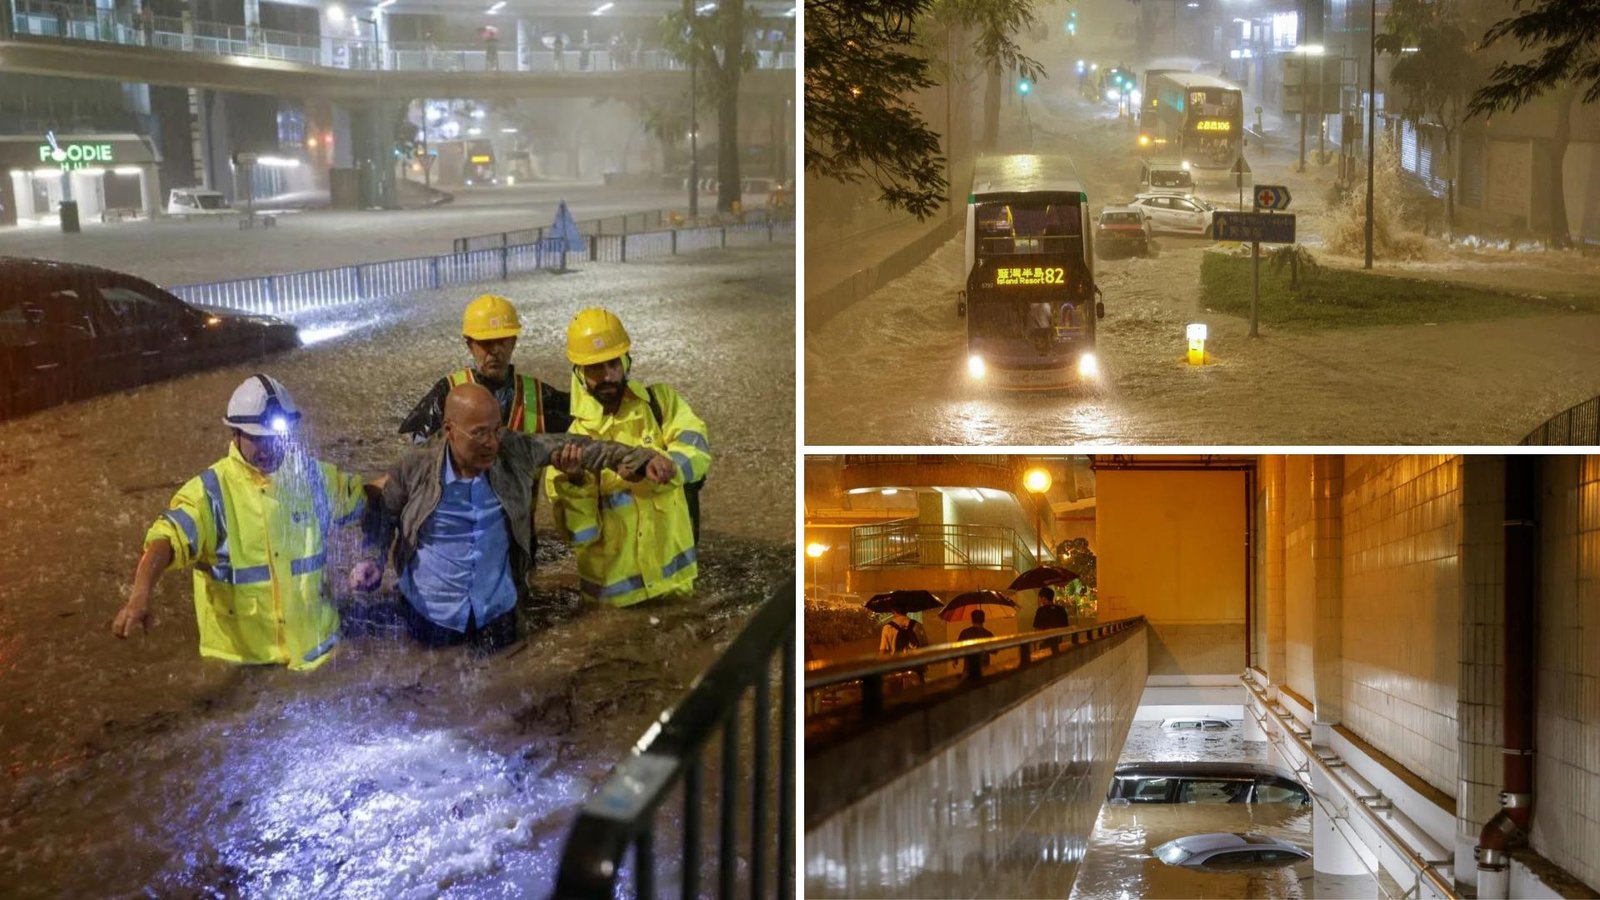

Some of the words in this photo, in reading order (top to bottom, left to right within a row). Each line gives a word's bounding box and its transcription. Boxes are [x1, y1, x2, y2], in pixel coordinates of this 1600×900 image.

[997, 277, 1018, 285] Island
[1019, 277, 1045, 285] Resort
[1045, 267, 1065, 284] 82
